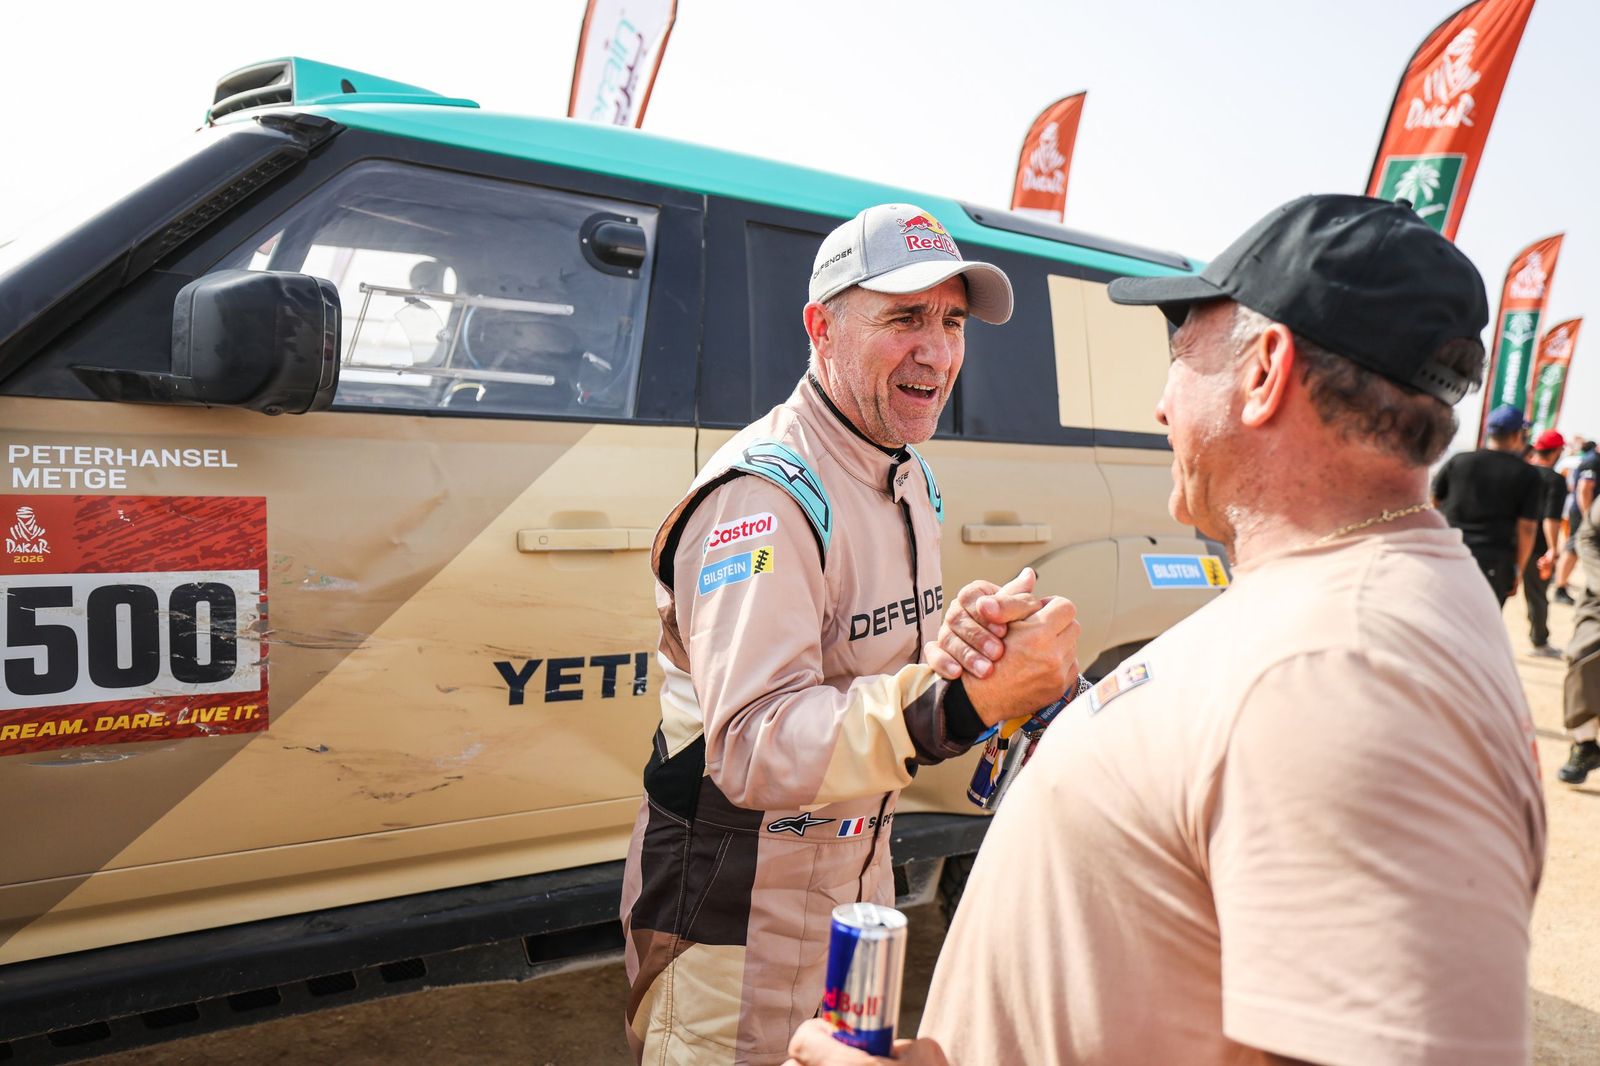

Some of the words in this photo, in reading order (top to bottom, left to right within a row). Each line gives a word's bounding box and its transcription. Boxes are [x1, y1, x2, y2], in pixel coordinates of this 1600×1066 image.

[1404, 92, 1475, 130] DAKAR
[905, 233, 945, 250] Red
[8, 444, 238, 468] PETERHANSEL
[12, 467, 127, 489] METGE
[5, 538, 51, 554] DAKAR
[13, 555, 44, 564] 2026
[703, 561, 747, 586] BILSTEIN
[4, 582, 238, 696] 500
[493, 652, 648, 706] YETI
[94, 711, 171, 732] DARE.
[176, 706, 231, 725] LIVE
[233, 705, 260, 721] IT.
[839, 991, 878, 1018] Bull
